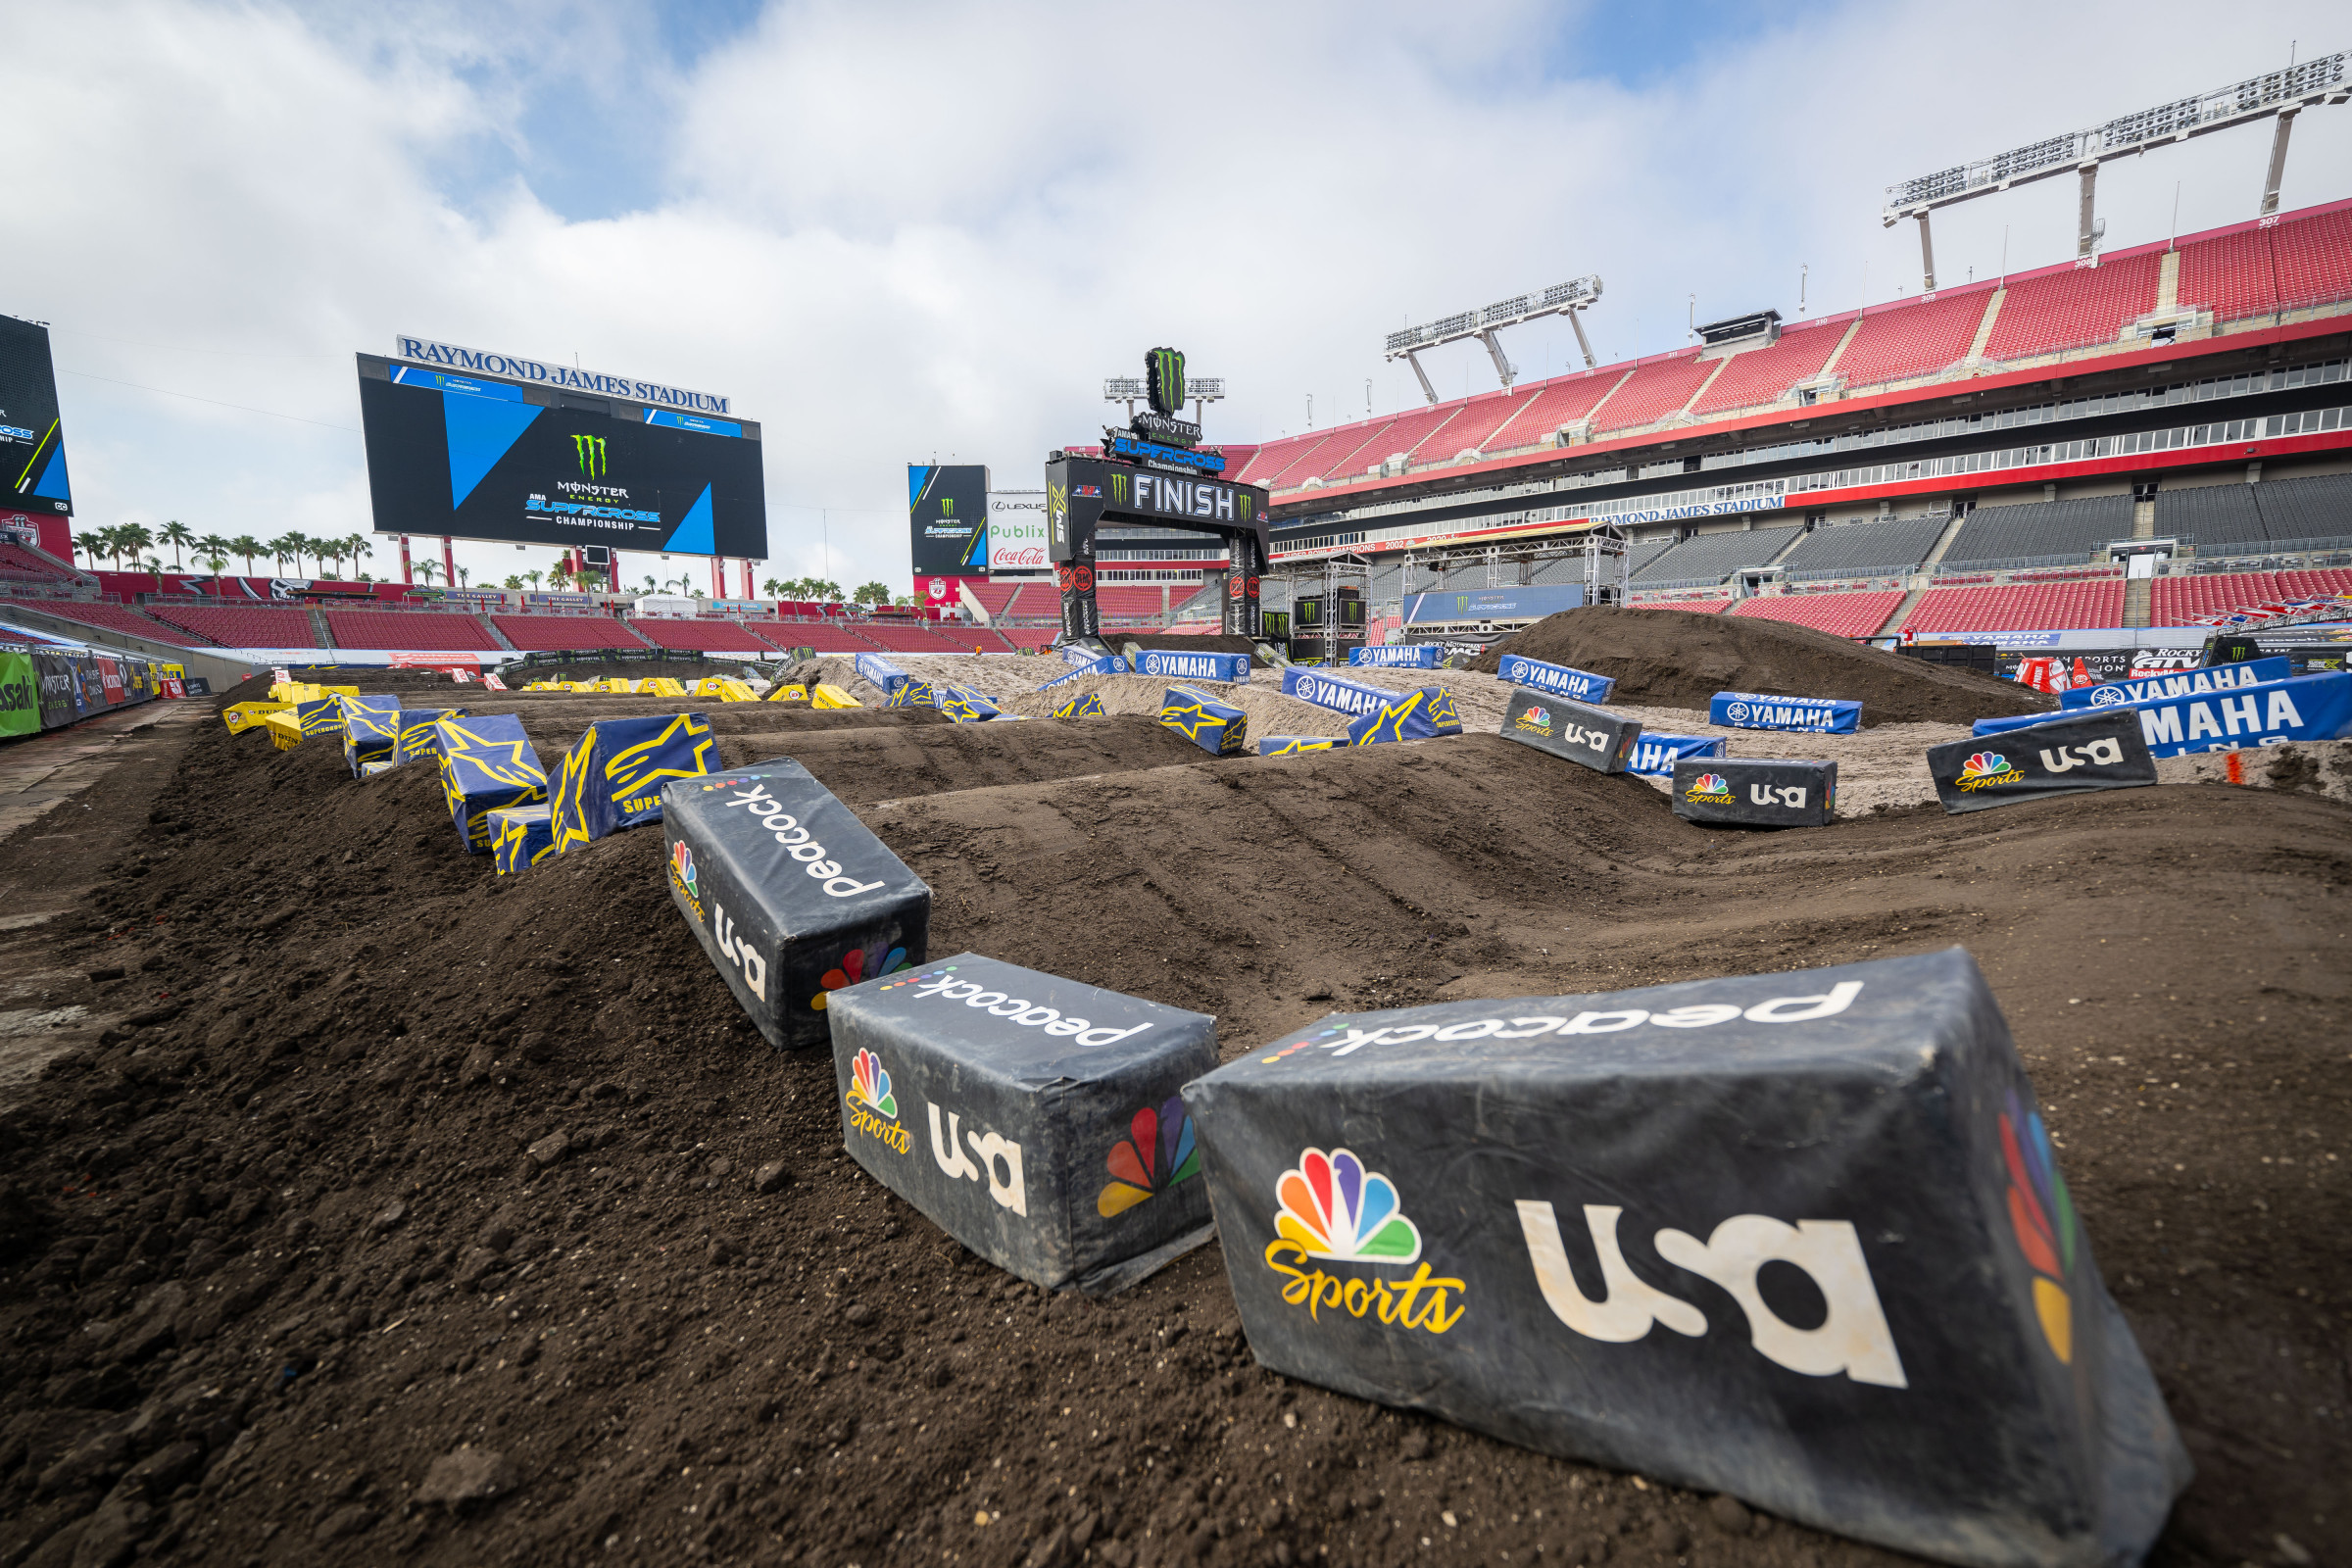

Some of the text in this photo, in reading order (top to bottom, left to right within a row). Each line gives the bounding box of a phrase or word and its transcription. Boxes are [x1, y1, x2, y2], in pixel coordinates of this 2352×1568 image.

[2258, 216, 2280, 226] 307
[2074, 258, 2092, 268] 308
[1921, 293, 1936, 302] 309
[402, 337, 728, 415] RAYMOND JAMES STADIUM
[1143, 414, 1202, 440] MONSTER
[1152, 432, 1194, 445] ENERGY
[1113, 438, 1226, 471] SUPERCROSS
[1148, 460, 1198, 475] Championship
[557, 481, 629, 499] MONSTER
[569, 494, 619, 504] ENERGY
[1134, 474, 1235, 520] FINISH
[524, 499, 662, 522] SUPERCROSS
[1661, 504, 1711, 520] JAMES
[1713, 495, 1784, 515] STADIUM
[556, 515, 635, 530] CHAMPIONSHIP
[990, 525, 1045, 538] Publix
[1330, 544, 1376, 554] CHAMPIONS
[1385, 540, 1404, 550] 2002
[1372, 647, 1421, 662] YAMAHA
[2156, 648, 2204, 657] ROCKY
[1161, 656, 1217, 678] YAMAHA
[1529, 665, 1591, 696] YAMAHA
[2125, 664, 2260, 704] YAMAHA
[1751, 704, 1835, 728] YAMAHA
[2138, 689, 2305, 746] MAHA
[305, 723, 344, 737] SUPERCROS
[1515, 716, 1610, 754] Sports usa
[1955, 737, 2125, 793] Sports usa
[1685, 783, 1807, 808] Sports usa
[725, 783, 886, 898] peacock
[669, 859, 766, 1003] Sports usa
[912, 974, 1154, 1048] peacock
[1330, 980, 1864, 1057] peacock
[844, 1089, 1027, 1218] Sports usa
[1265, 1198, 1909, 1391] Sports usa
